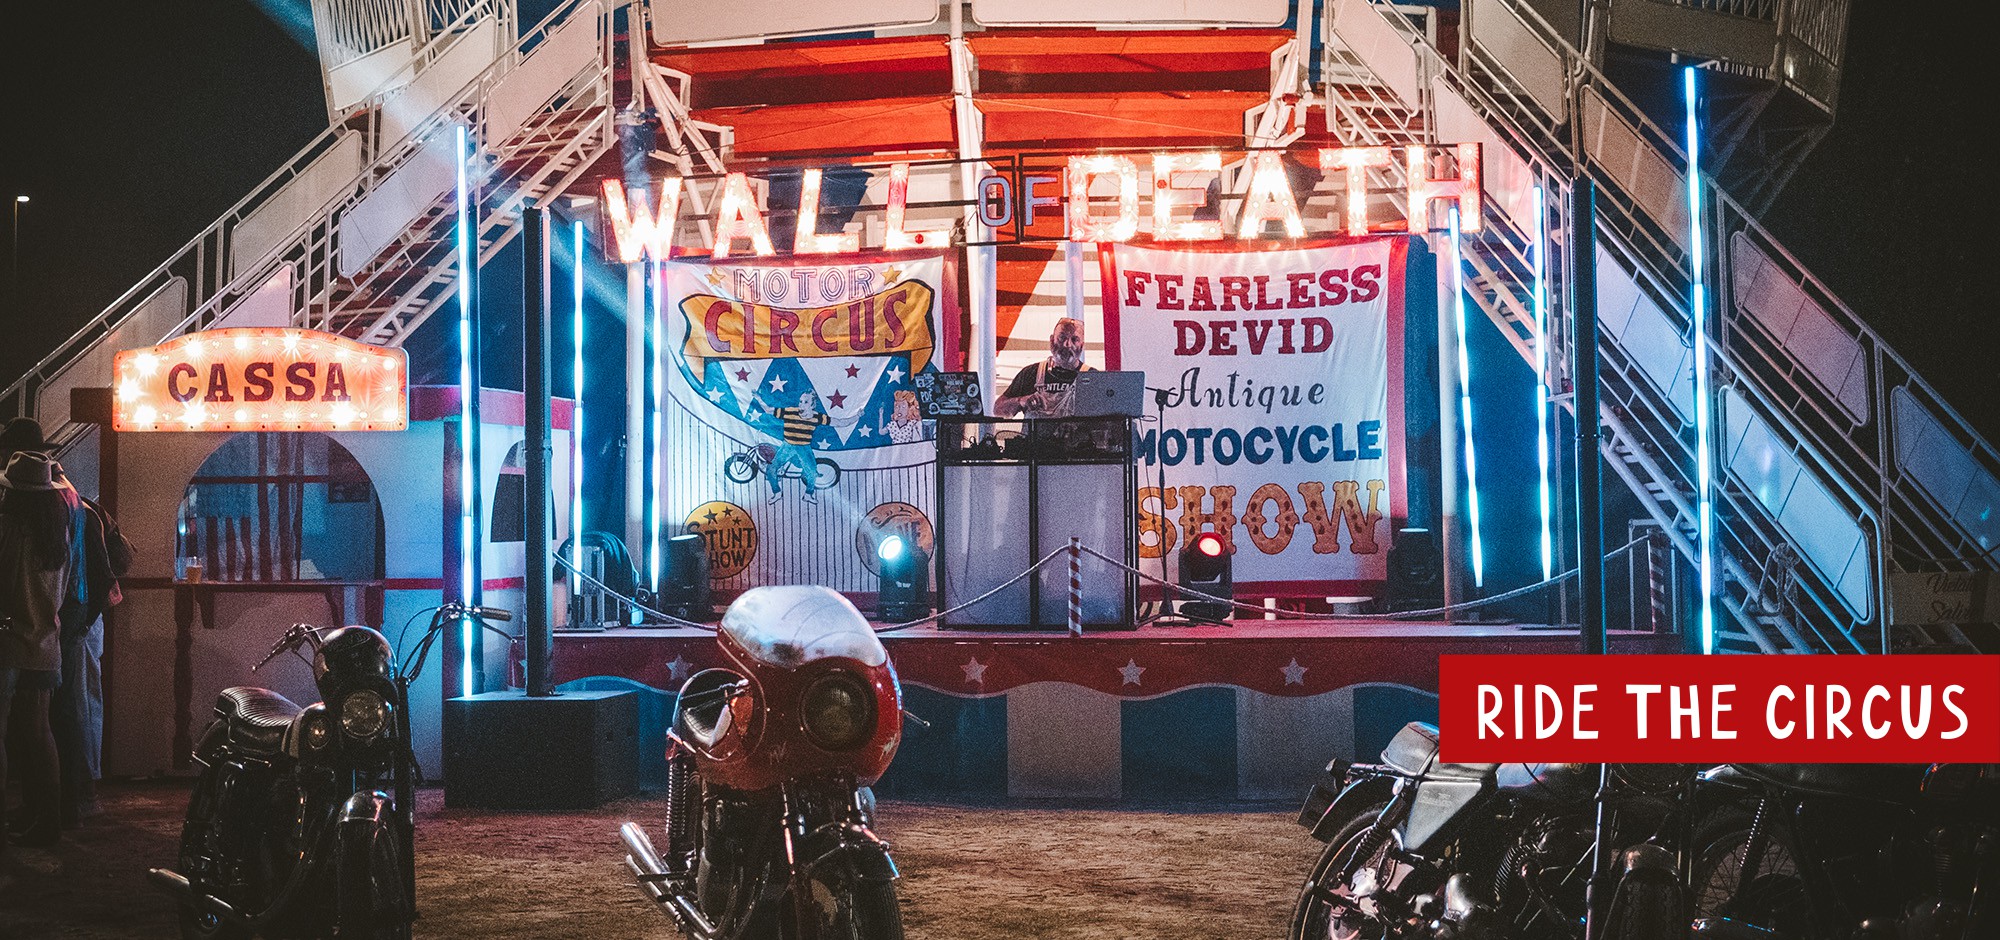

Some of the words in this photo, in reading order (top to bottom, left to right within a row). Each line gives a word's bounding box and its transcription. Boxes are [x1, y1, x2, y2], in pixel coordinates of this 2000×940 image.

[601, 162, 951, 263] WALL
[977, 174, 1060, 228] OF
[1067, 143, 1484, 243] DEATH
[733, 267, 874, 304] MOTOR
[1122, 264, 1382, 312] FEARLESS
[703, 290, 907, 354] CIRCUS
[1173, 316, 1334, 356] DEVID
[167, 362, 351, 402] CASSA
[1162, 366, 1325, 413] Antique
[1134, 420, 1382, 466] MOTOCYCLE
[687, 521, 754, 551] STUNT
[1137, 480, 1384, 558] SHOW
[709, 550, 746, 569] HOW
